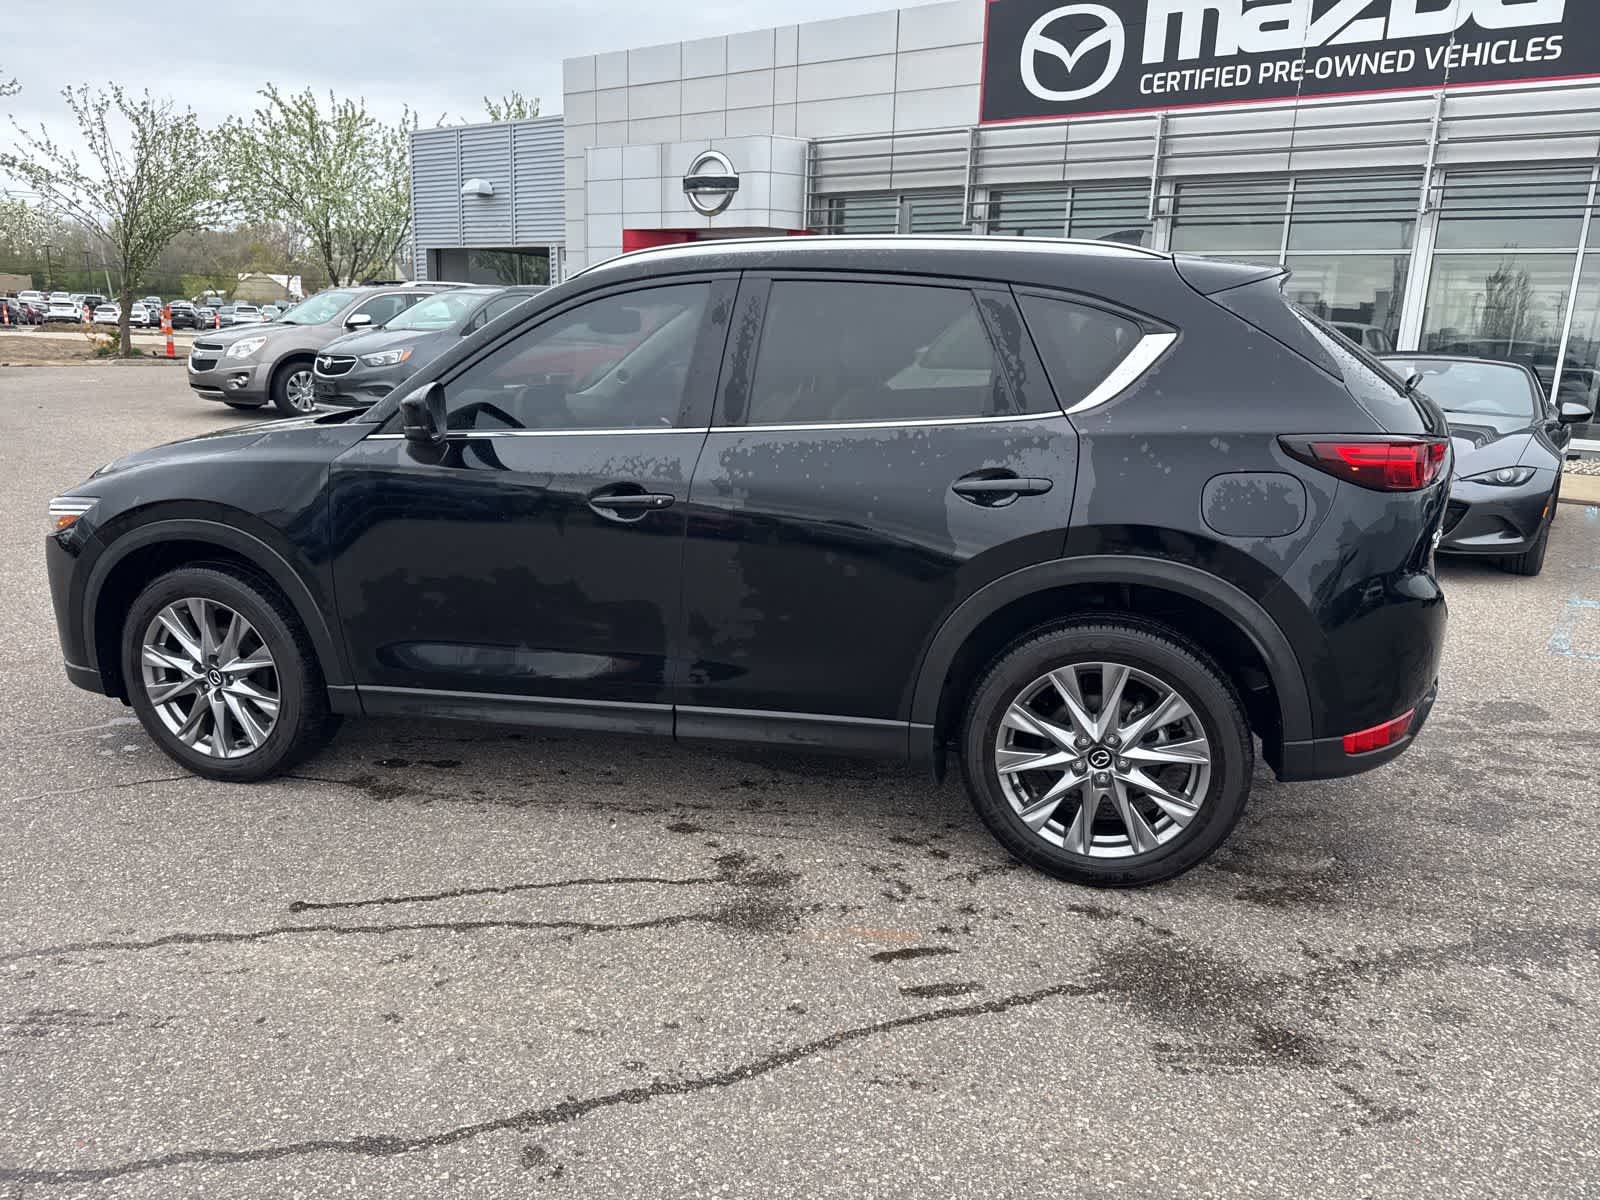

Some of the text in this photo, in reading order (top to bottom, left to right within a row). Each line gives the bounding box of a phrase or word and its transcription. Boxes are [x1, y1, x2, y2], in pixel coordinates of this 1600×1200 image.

[1140, 35, 1563, 94] CERTIFIED PRE-OWNED VEHICLES
